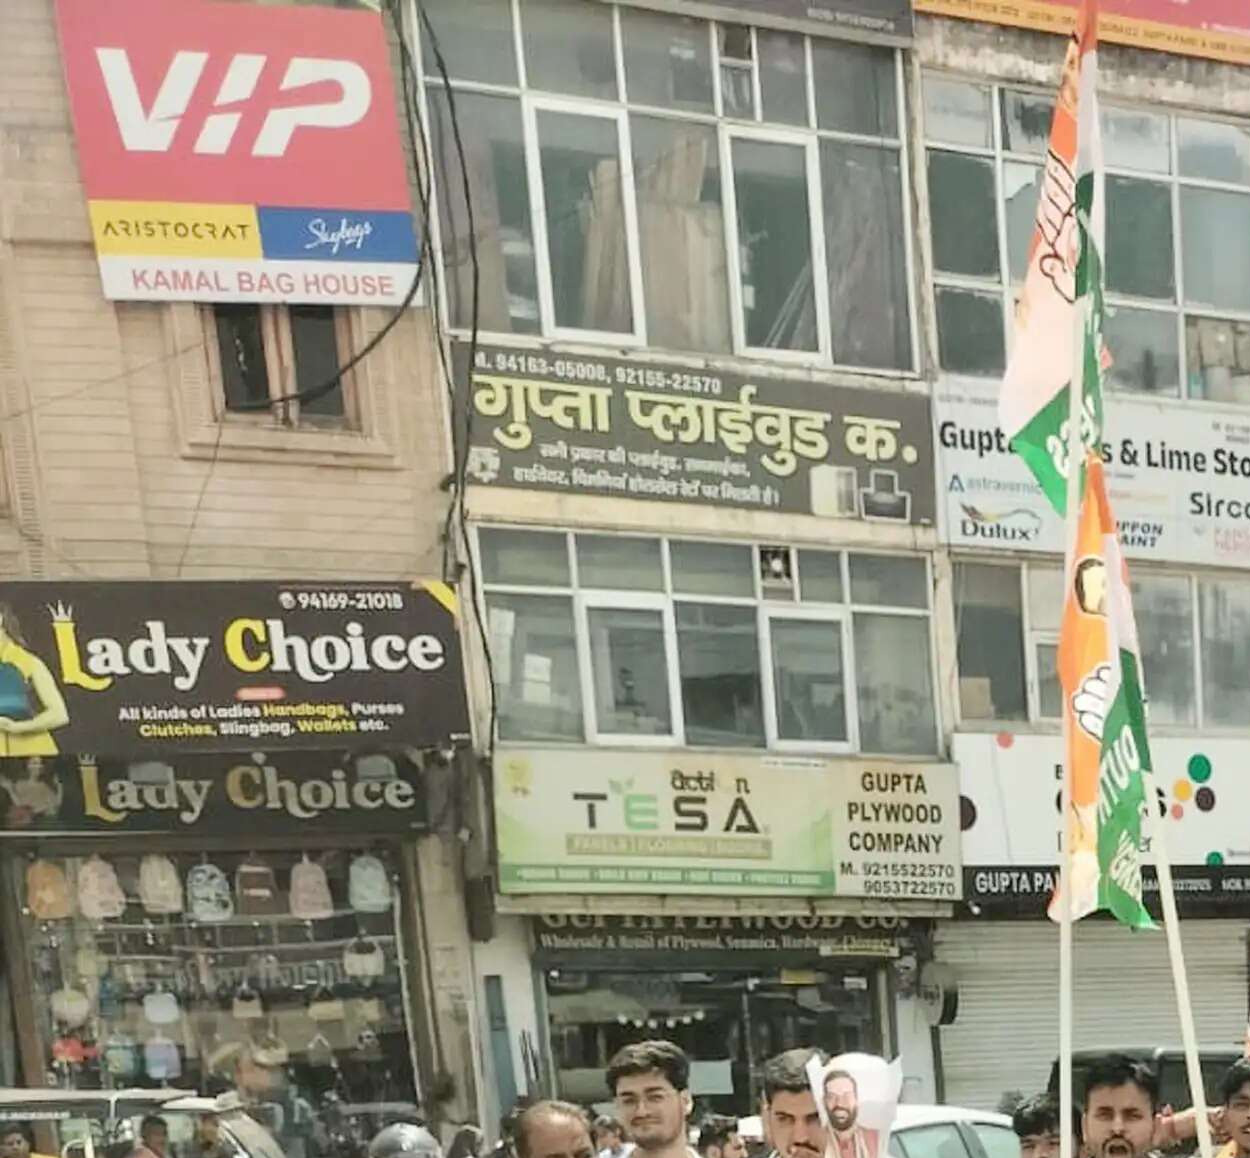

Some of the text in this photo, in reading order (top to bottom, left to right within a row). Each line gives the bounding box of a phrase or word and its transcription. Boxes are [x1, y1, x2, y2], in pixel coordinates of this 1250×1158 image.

[95, 48, 372, 156] VIP
[103, 220, 250, 241] ARISTOCRAT
[132, 269, 395, 296] KAMAL BAG HOUSE
[472, 375, 918, 476] गुप्ता प्लाईवुड क.
[1120, 438, 1138, 466] &
[1146, 441, 1207, 473] Lime
[961, 519, 1031, 541] Dulux
[1120, 535, 1157, 548] AINT
[52, 617, 445, 691] Lady Choice
[119, 707, 139, 721] All
[142, 706, 187, 720] kinds
[189, 706, 207, 719] of
[209, 705, 261, 719] Ladies
[351, 703, 404, 717] Purses
[297, 719, 356, 733] Wallets
[78, 763, 415, 824] Lady Choice
[861, 772, 927, 794] GUPTA
[573, 793, 760, 834] TESA
[848, 802, 942, 823] PLYWOOD
[849, 832, 942, 854] COMPANY
[975, 872, 1031, 893] GUPTA
